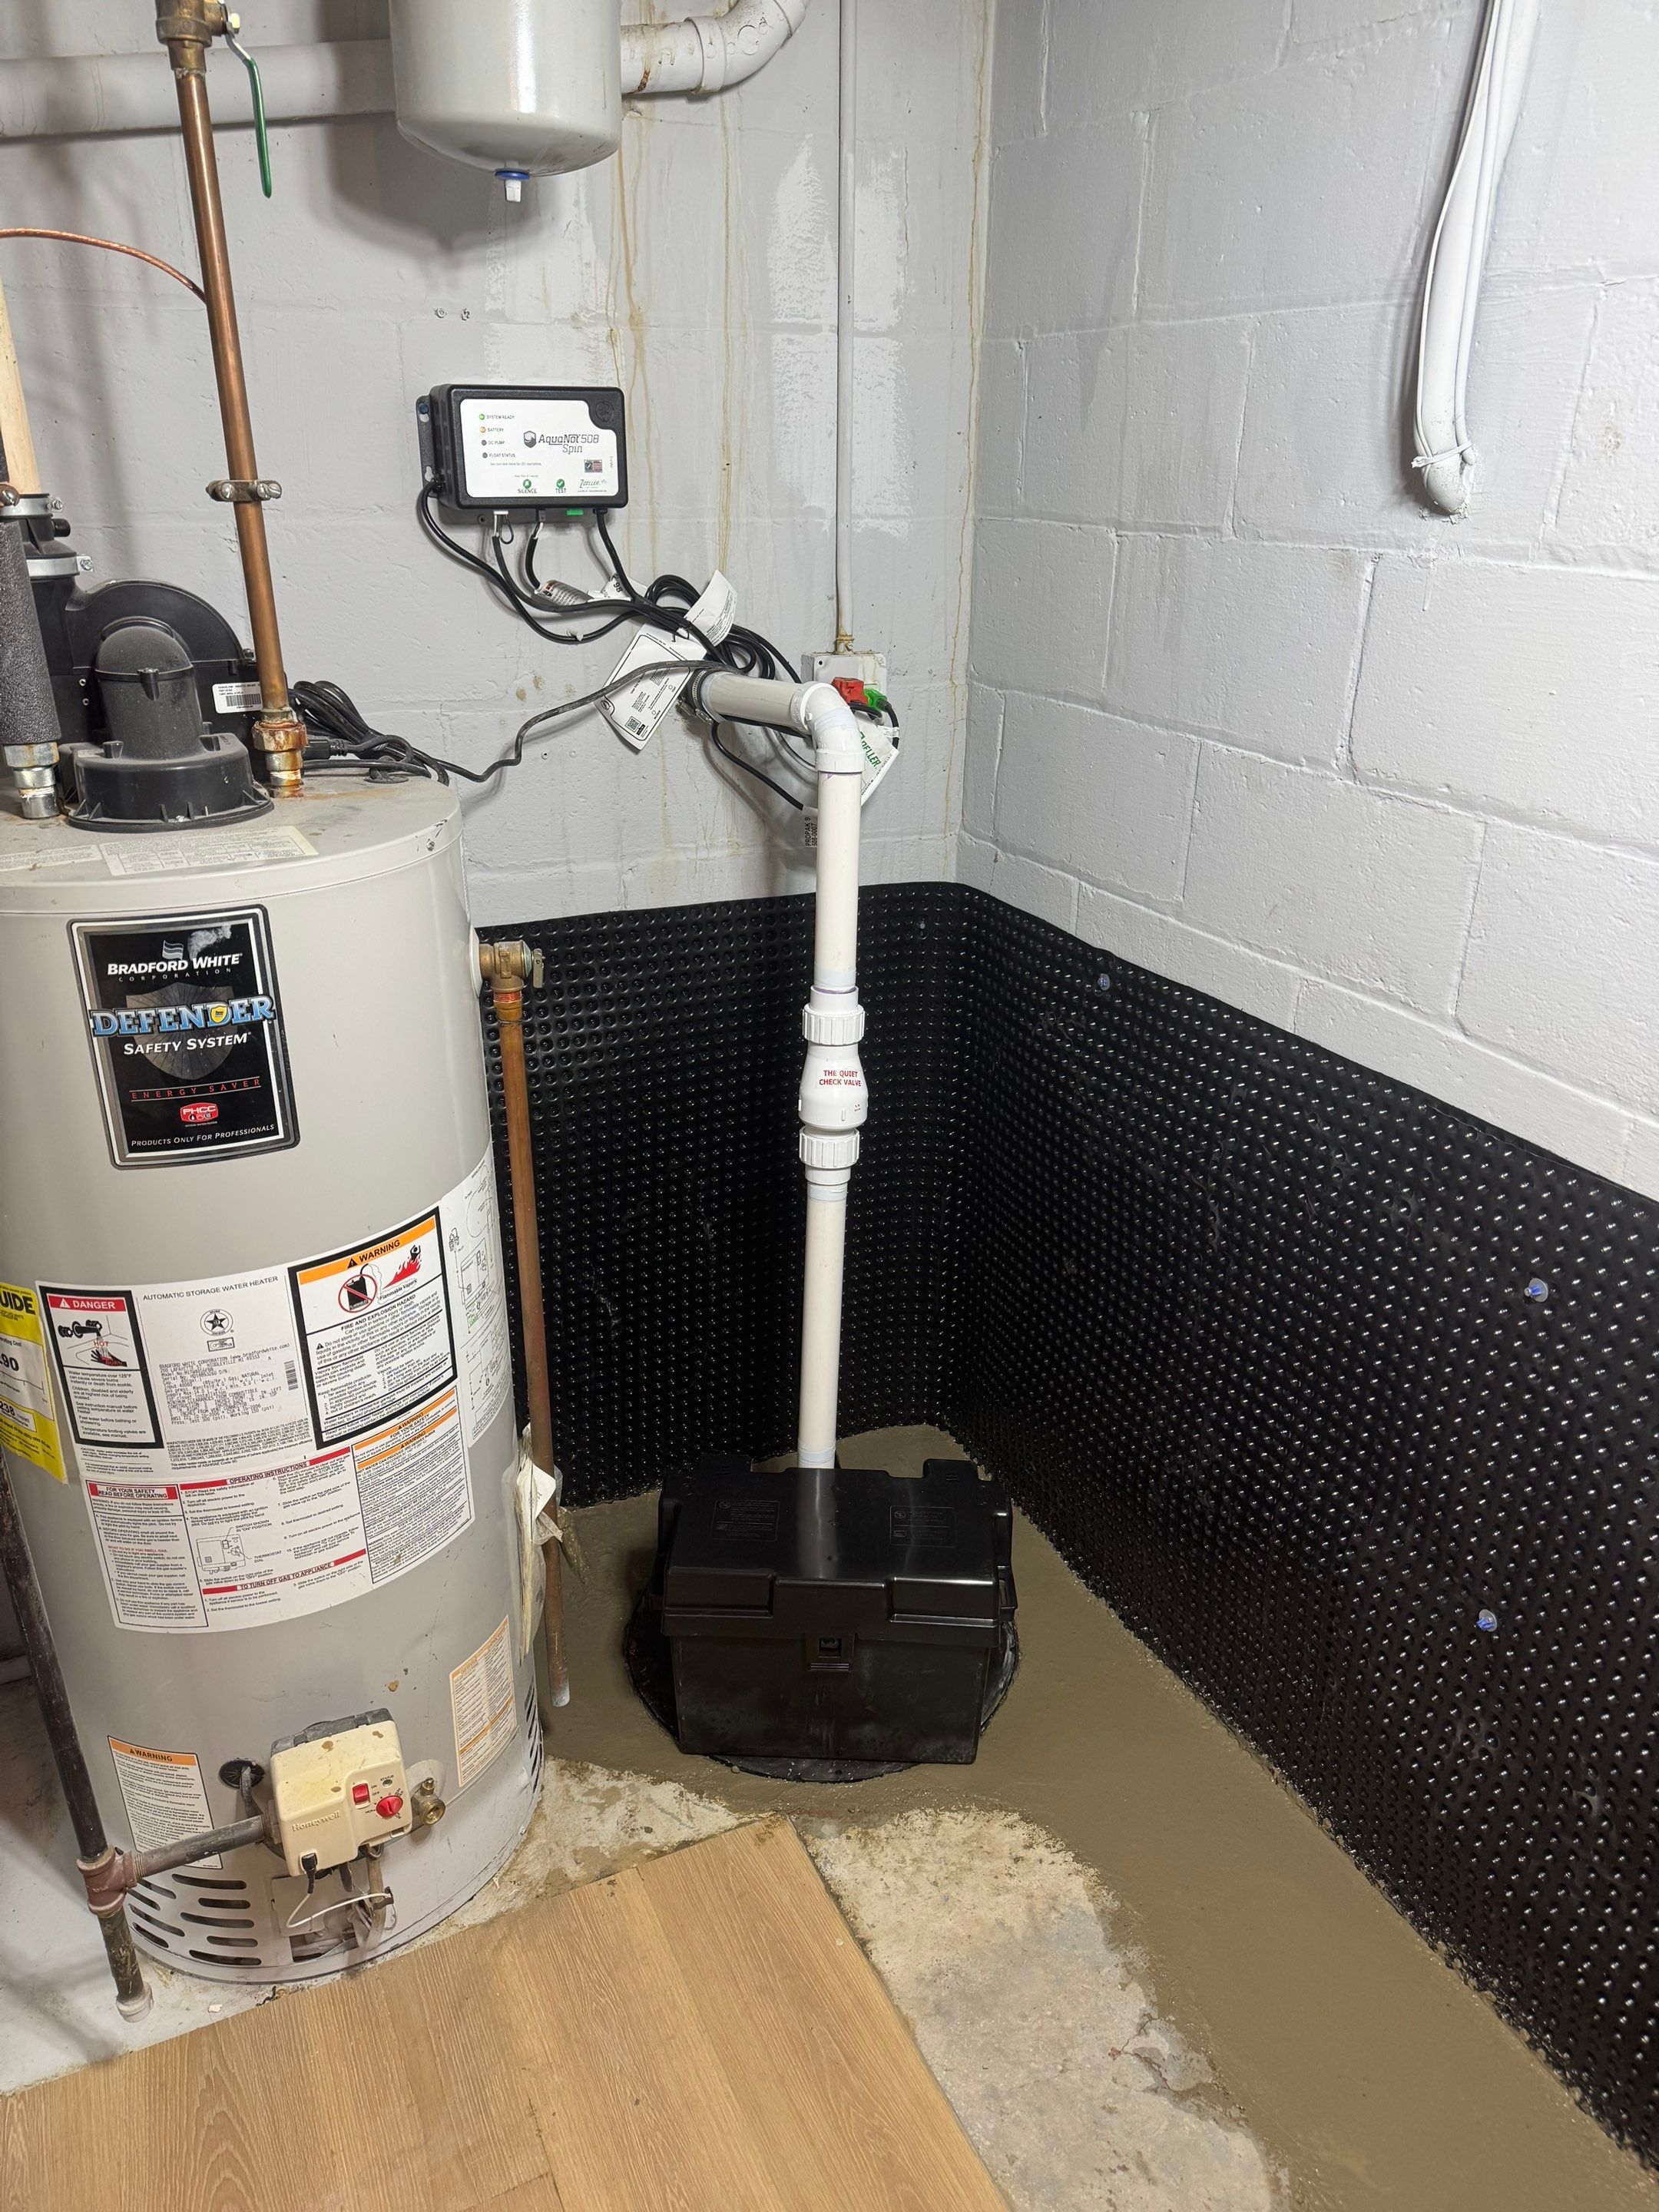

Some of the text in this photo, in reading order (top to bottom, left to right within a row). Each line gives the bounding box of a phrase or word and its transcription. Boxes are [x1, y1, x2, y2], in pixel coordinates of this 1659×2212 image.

[581, 434, 599, 443] 508
[562, 444, 582, 455] Spin
[108, 954, 240, 975] BRADFORD WHITE
[119, 969, 231, 982] CORPORATION
[91, 995, 274, 1035] DEFENDER
[124, 1033, 247, 1055] SAFETY SYSTEM
[131, 1079, 260, 1099] ENERGY SAVER
[182, 1105, 216, 1114] PHCC
[131, 1138, 171, 1147] PRODUCTS
[174, 1136, 194, 1144] ONLY
[214, 1124, 274, 1139] PROFESSIONALS
[359, 1239, 400, 1263] WARNING
[143, 1276, 279, 1300] AUTOMATIC STORAGE WATER HEATER
[380, 1280, 417, 1300] Flammable Vapors
[72, 1300, 115, 1310] DANGER
[341, 1323, 353, 1331] FIRE
[367, 1305, 396, 1321] EXPLOSION
[397, 1294, 416, 1306] HAZARD
[367, 1321, 385, 1332] gasoline
[373, 1315, 387, 1324] serious
[0, 1353, 19, 1372] 90
[197, 1356, 227, 1365] CORPORATION
[400, 1426, 412, 1435] YOUR
[412, 1414, 430, 1428] SAFETY
[402, 1412, 424, 1428] WARNING
[404, 1431, 426, 1448] WARNING
[230, 1462, 307, 1485] OPERATING INSTRUCTIONS
[300, 1562, 332, 1577] APPLIANCE
[134, 1750, 173, 1762] WARNING
[292, 1810, 340, 1833] Honeywell
